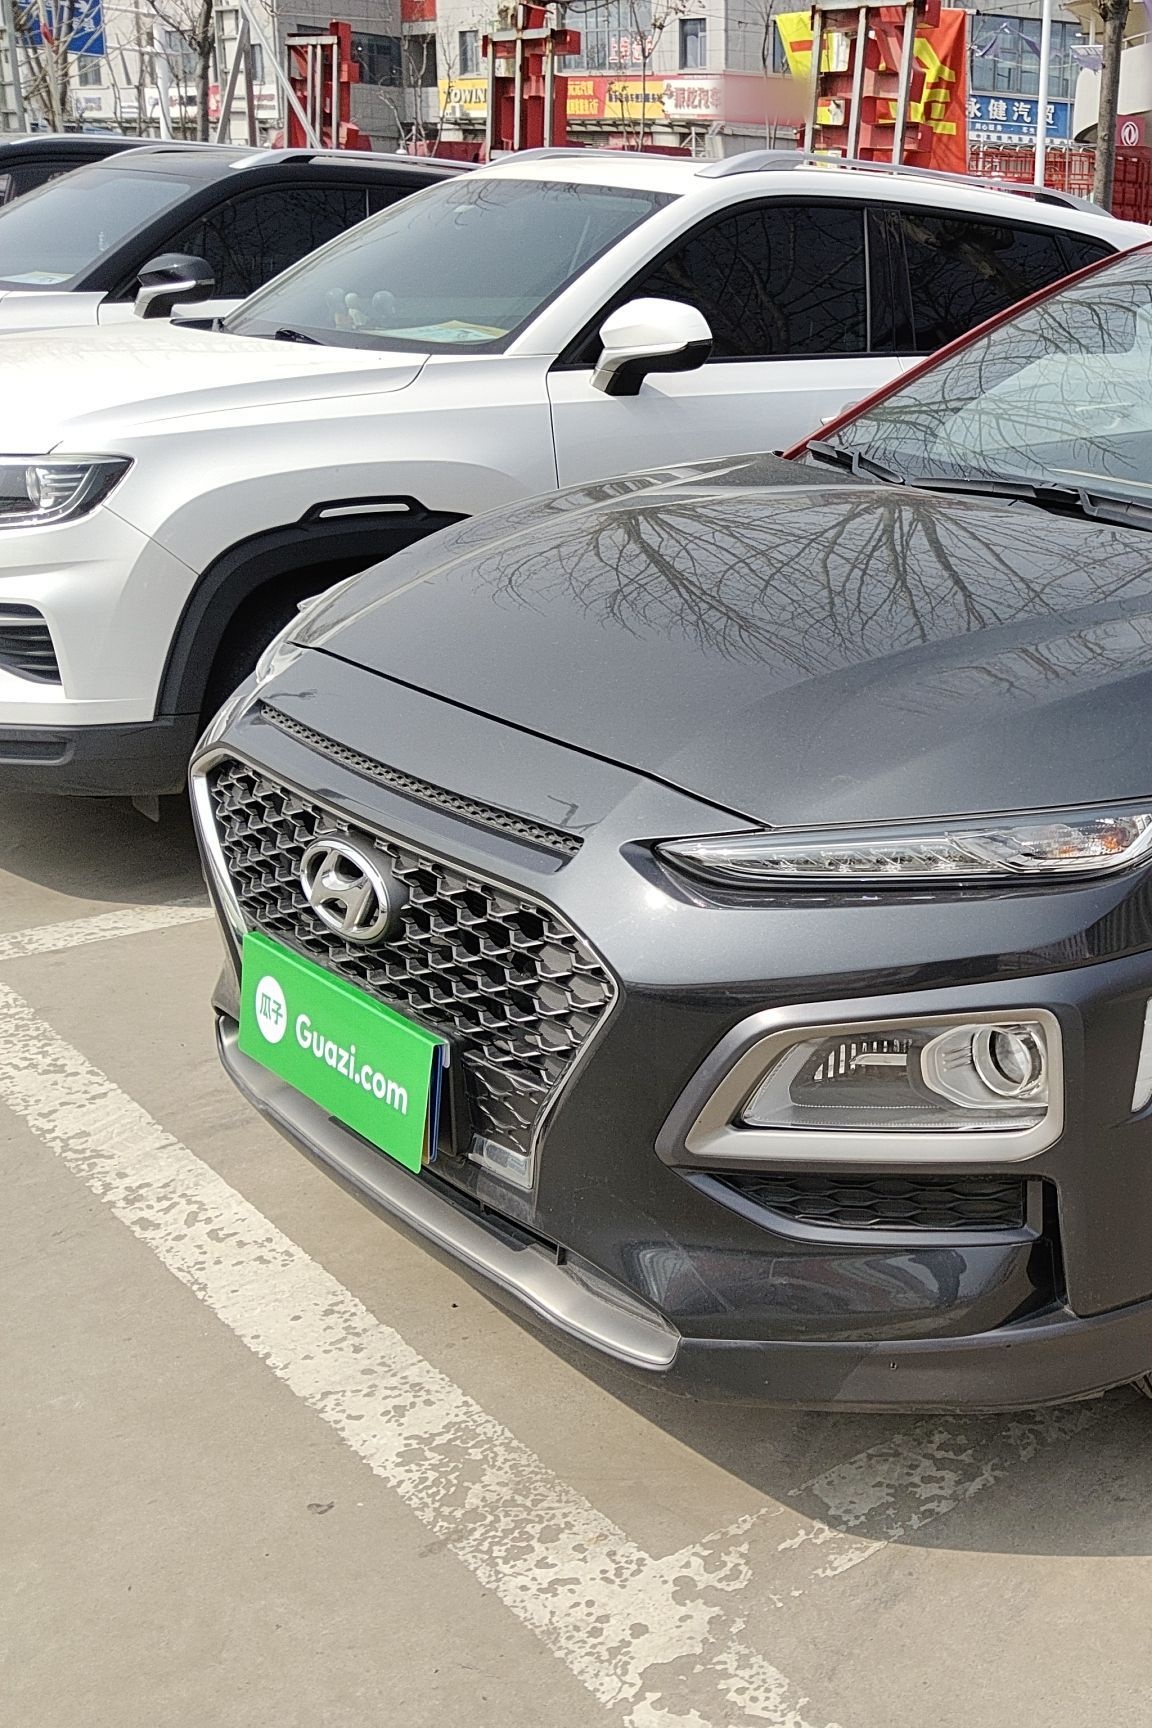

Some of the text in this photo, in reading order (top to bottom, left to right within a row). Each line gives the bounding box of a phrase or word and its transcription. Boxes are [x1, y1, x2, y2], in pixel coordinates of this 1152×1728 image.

[965, 97, 1055, 125] 永健汽贸
[260, 992, 284, 1026] 瓜子
[295, 1013, 409, 1116] Guazi.com
